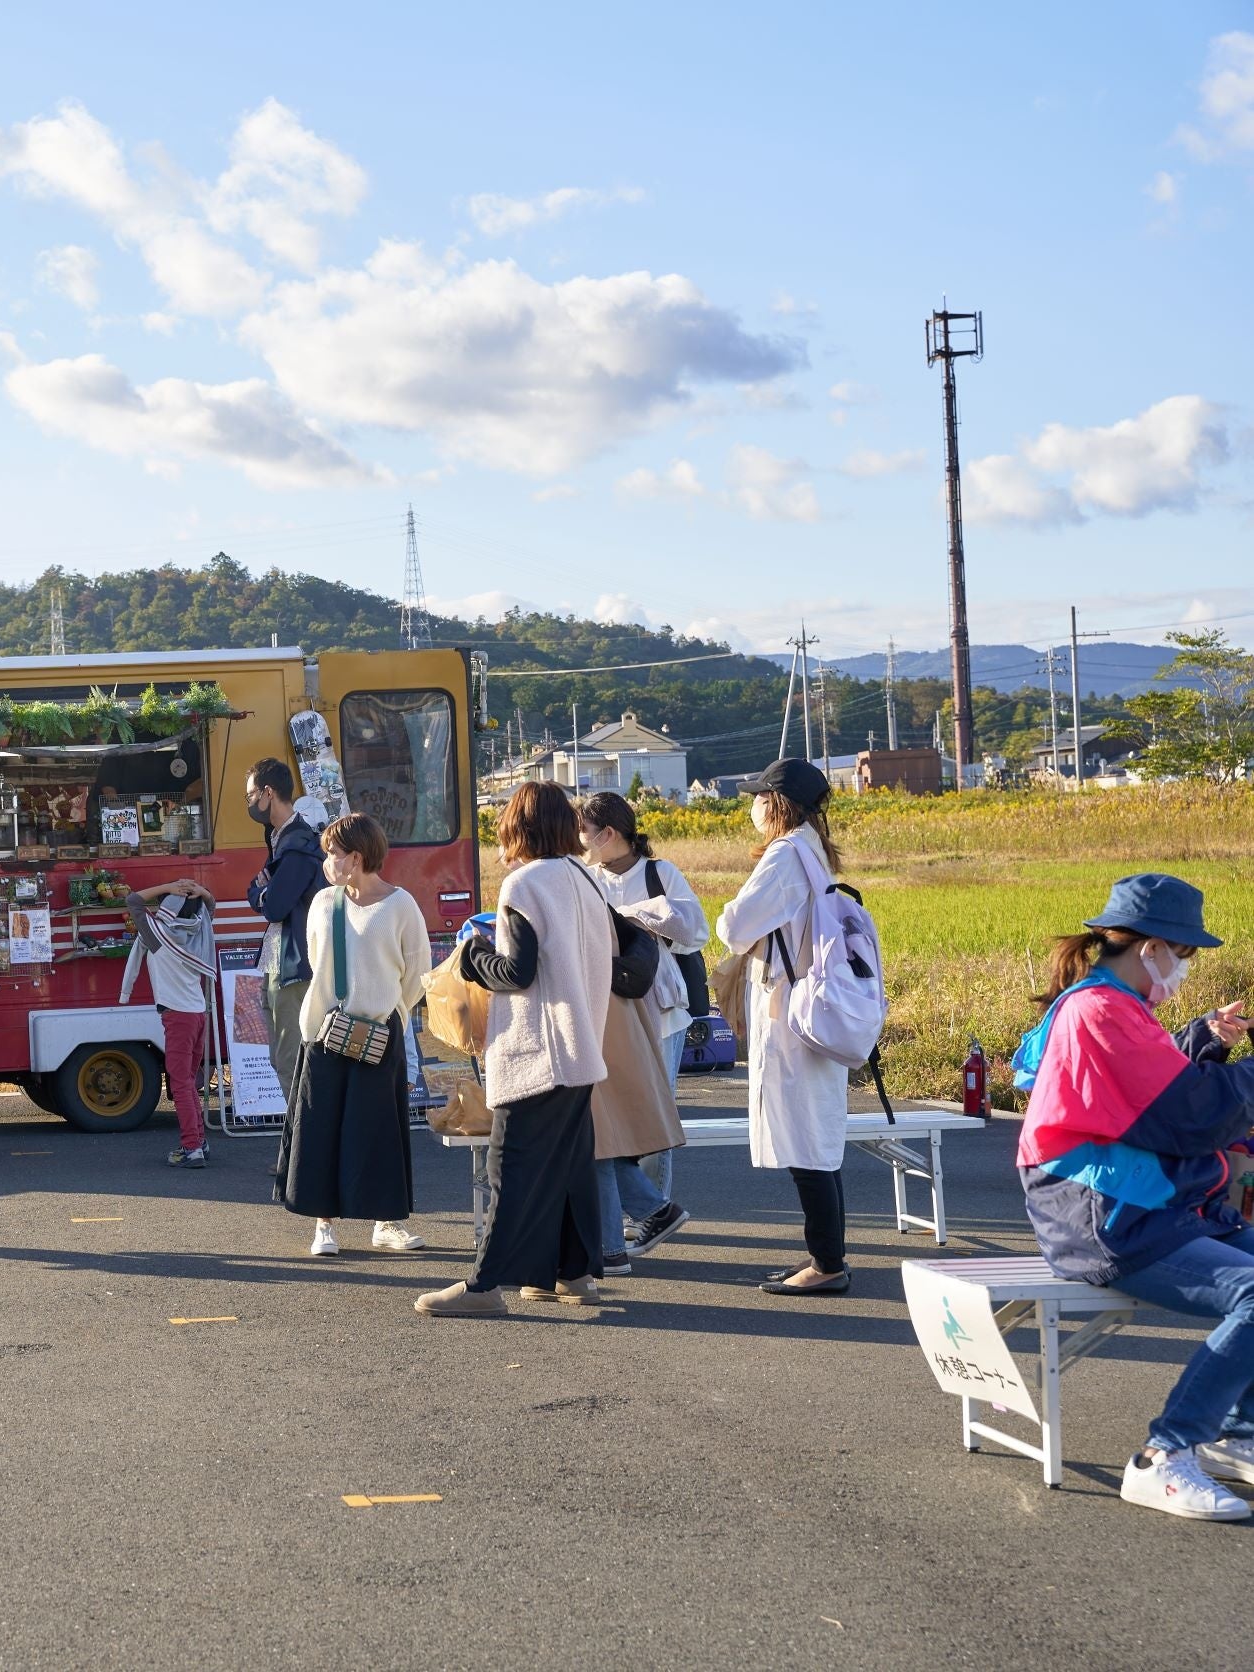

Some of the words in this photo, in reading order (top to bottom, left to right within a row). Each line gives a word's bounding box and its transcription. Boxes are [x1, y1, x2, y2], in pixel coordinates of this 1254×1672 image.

[934, 1352, 1018, 1389] 休憩コーナー
